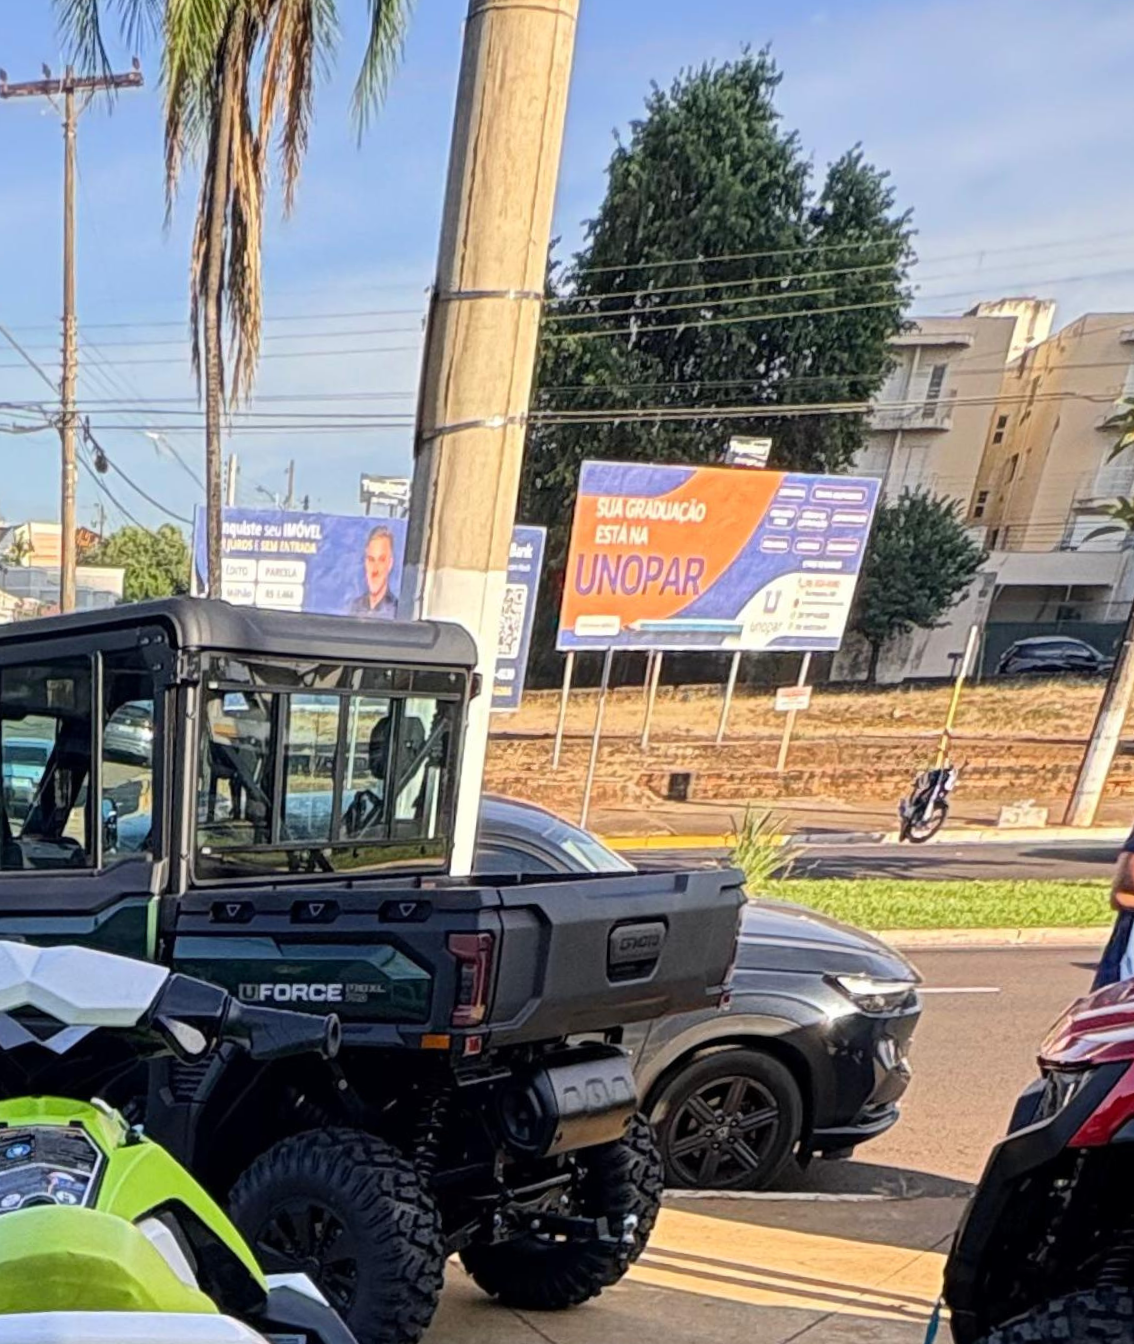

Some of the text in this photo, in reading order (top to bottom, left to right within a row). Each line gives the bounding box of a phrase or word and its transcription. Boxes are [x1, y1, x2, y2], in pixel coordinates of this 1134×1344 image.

[596, 498, 707, 523] SUA GRADUAÇÃO
[222, 519, 322, 540] nquiste seu IMÓVEL
[595, 521, 649, 545] ESTÁ NA
[575, 553, 706, 596] UNOPAR
